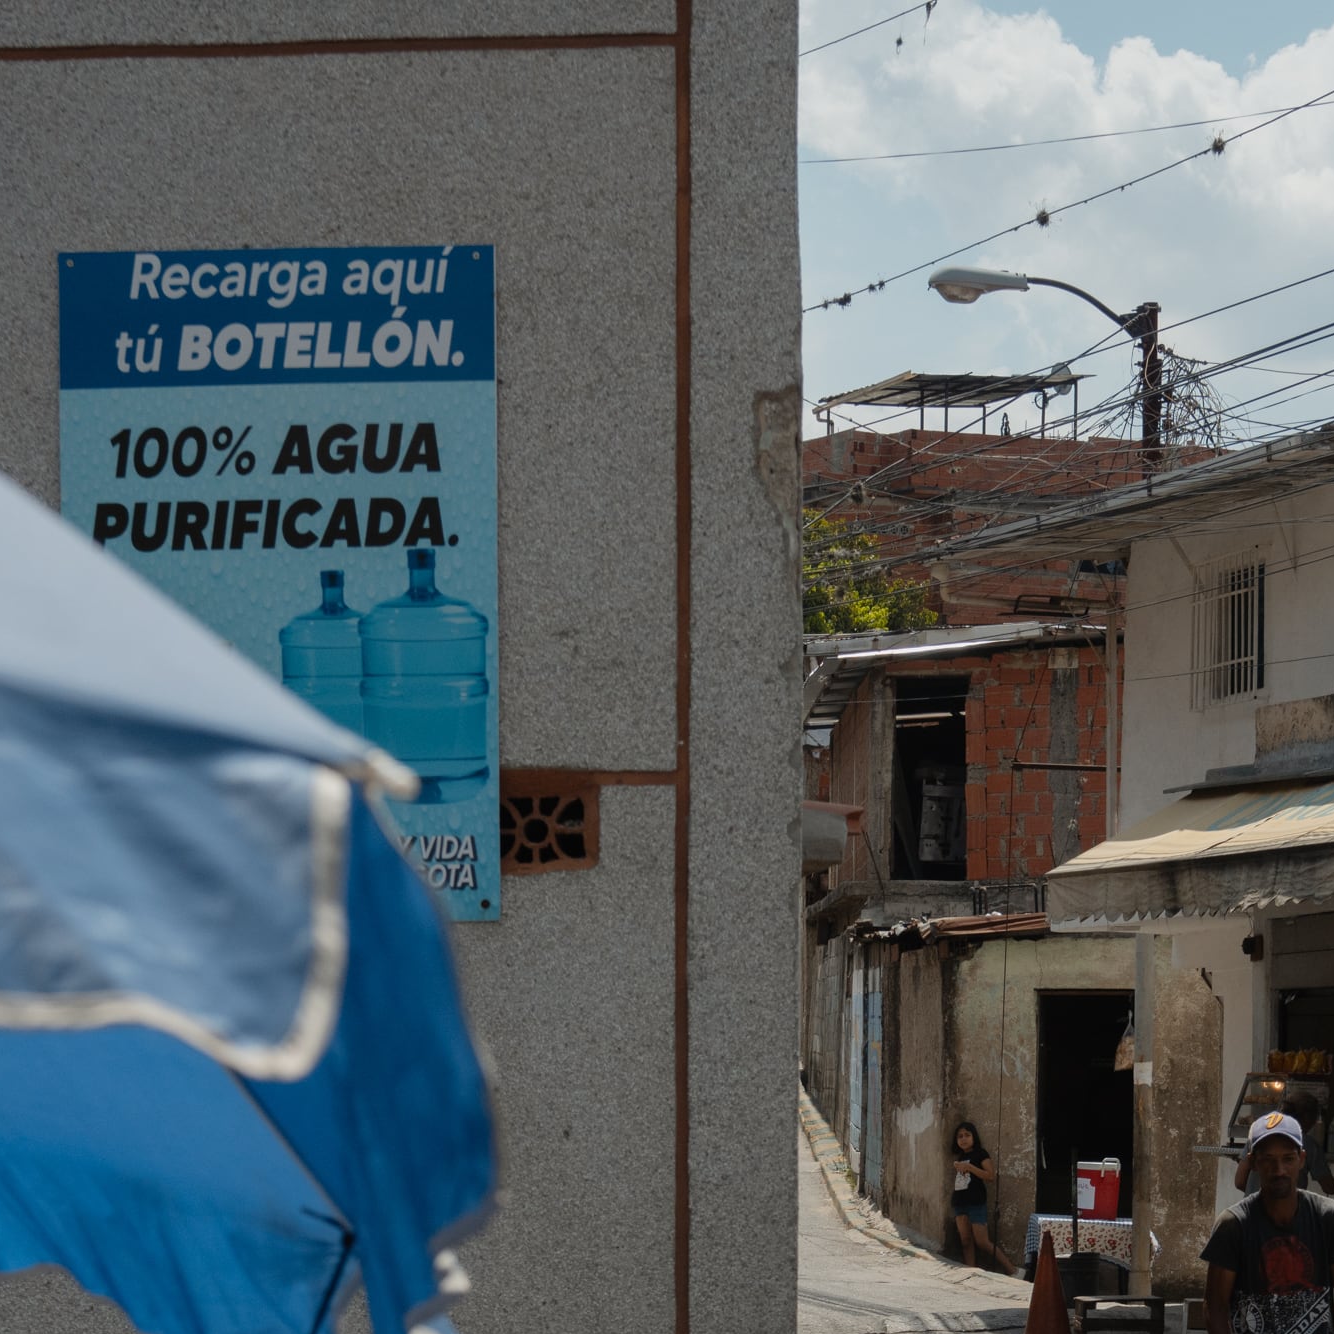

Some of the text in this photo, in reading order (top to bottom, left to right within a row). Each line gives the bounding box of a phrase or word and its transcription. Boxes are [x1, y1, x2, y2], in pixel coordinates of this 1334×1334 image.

[130, 245, 455, 308] Recarga aquí
[116, 305, 465, 373] tú BOTELLÓN.
[110, 422, 442, 478] 100% AGUA
[92, 497, 459, 552] PURIFICADA.
[419, 835, 477, 862] VIDA
